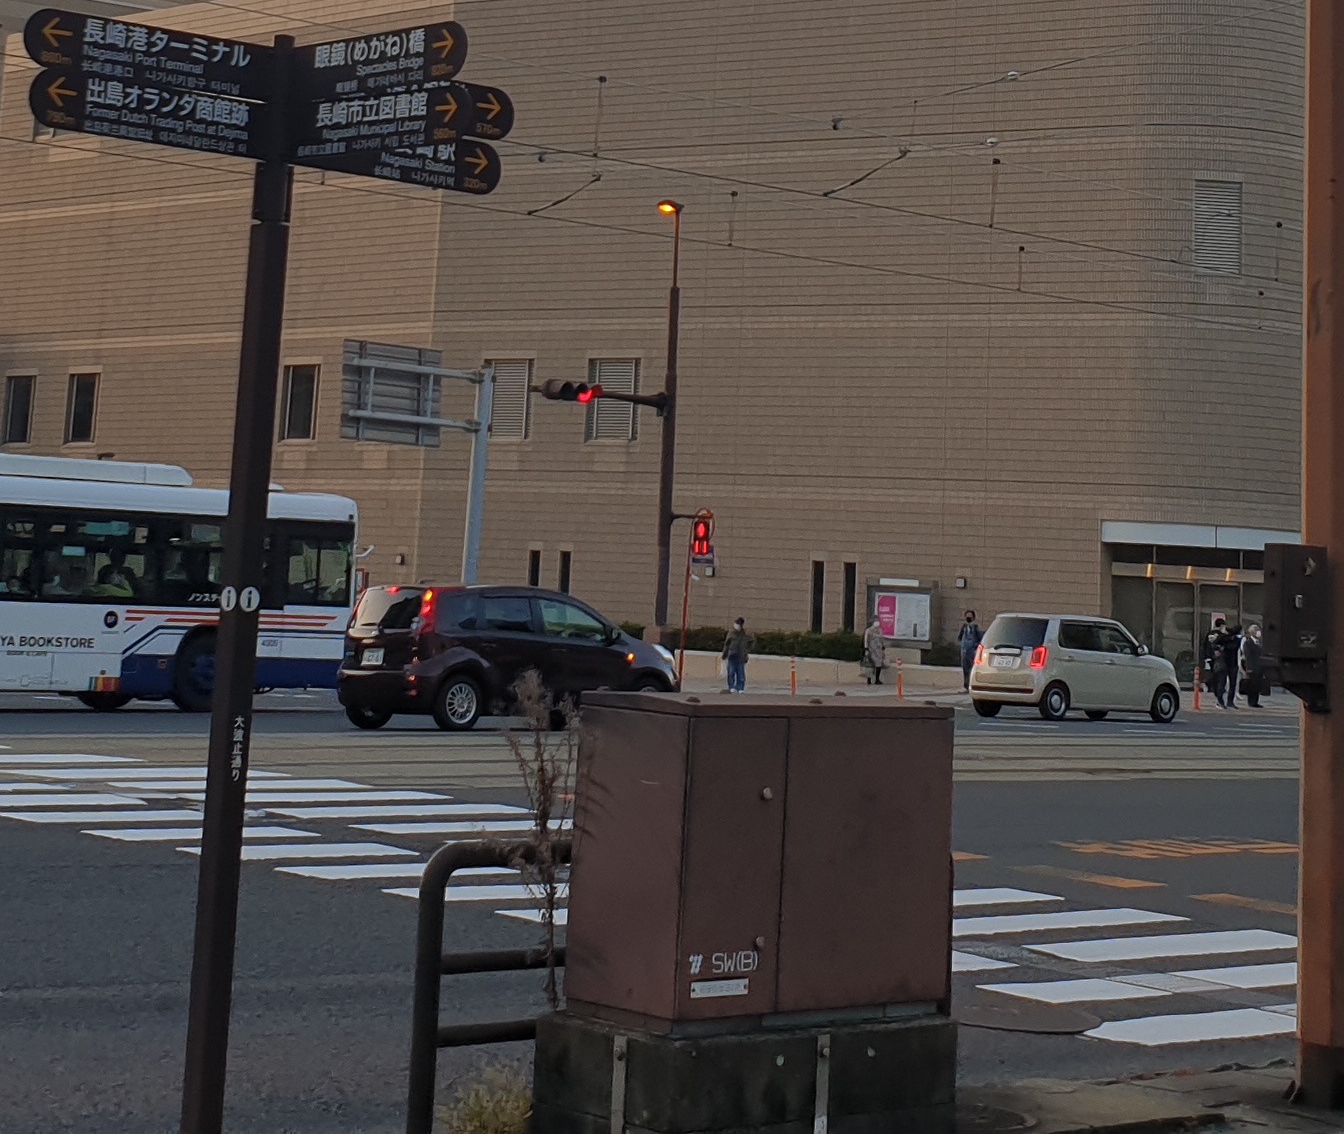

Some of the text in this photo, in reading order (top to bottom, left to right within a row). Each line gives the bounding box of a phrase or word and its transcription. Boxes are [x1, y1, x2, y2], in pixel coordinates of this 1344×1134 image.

[83, 19, 251, 67] 長崎港ターミナル
[313, 28, 426, 68] 眼鏡(めがね)橋
[83, 45, 204, 74] Nagasaki Port Terminal
[356, 57, 424, 77] Spectacles Bridge
[86, 78, 250, 127] 出島オランダ商館跡
[315, 91, 428, 129] 長崎市立図書館
[86, 104, 249, 140] Former Dutch Trading Post at Dejima
[323, 119, 426, 142] Nagasaki Municipal Library
[381, 152, 455, 174] Nagasaki Station
[188, 592, 221, 602] ノンステ
[19, 636, 95, 648] BOOKSTORE
[712, 950, 758, 974] SW(B)
